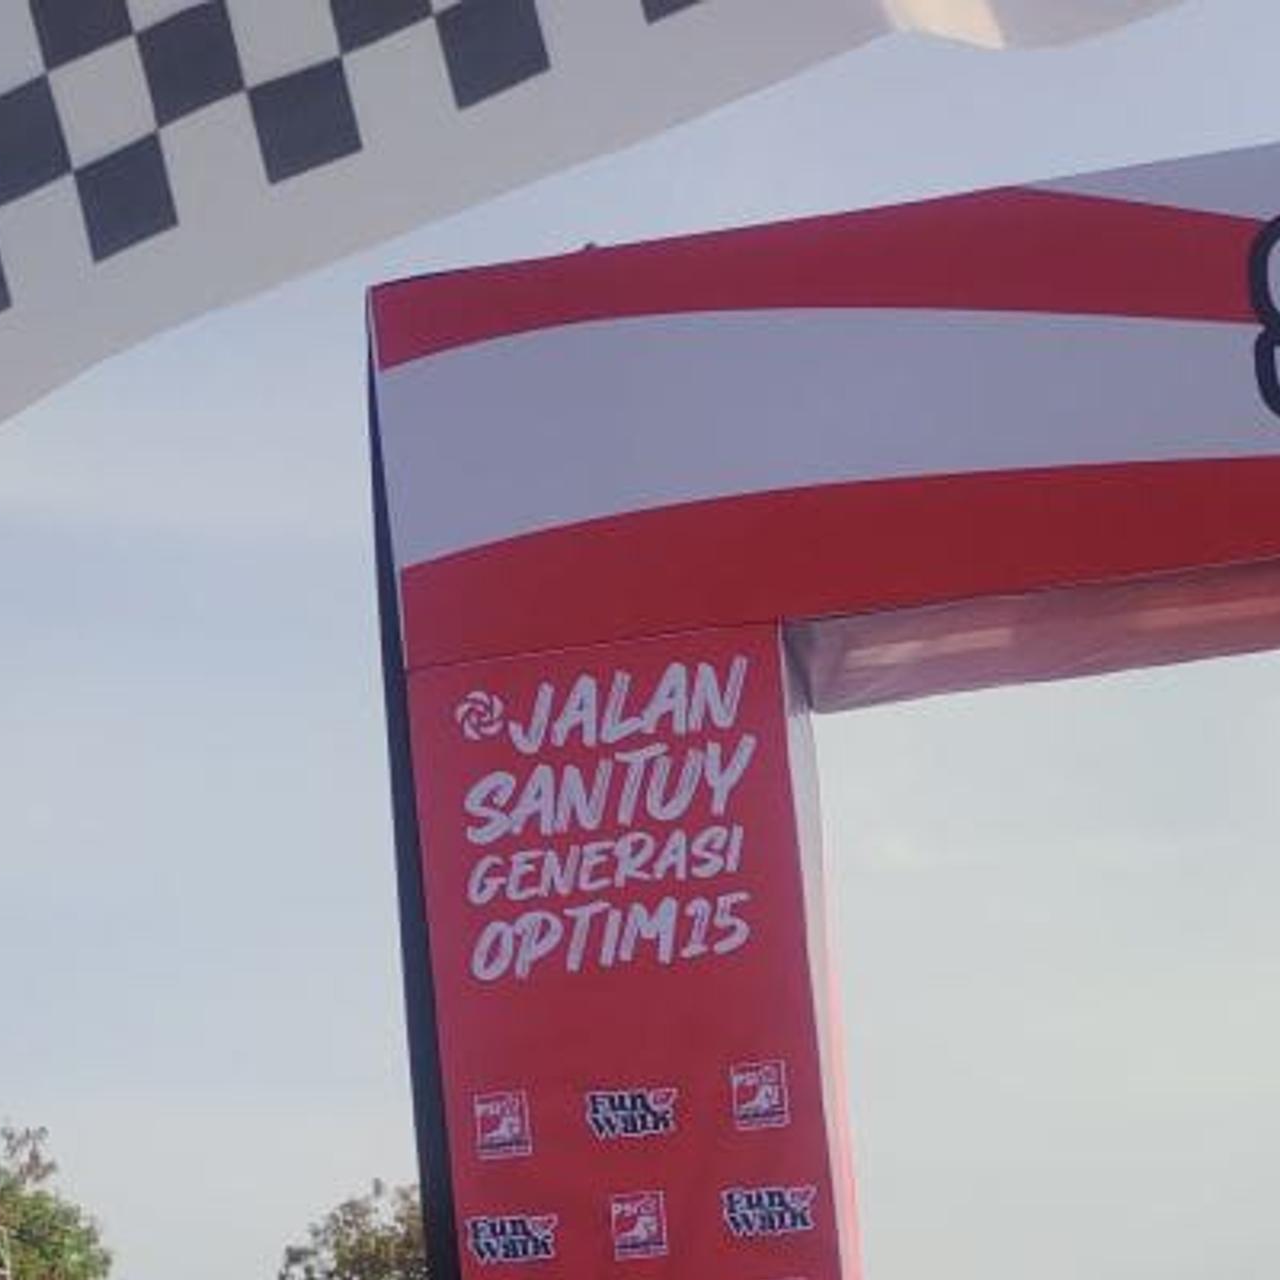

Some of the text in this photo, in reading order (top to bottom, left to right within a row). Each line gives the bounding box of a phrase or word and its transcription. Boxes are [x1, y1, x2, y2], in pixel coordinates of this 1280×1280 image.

[508, 656, 749, 754] JALAN
[464, 733, 758, 845] SANTUY
[467, 824, 745, 907] GENERASI
[589, 1093, 652, 1115] Fun
[727, 1190, 788, 1212] Fun
[471, 1219, 531, 1241] Fun
